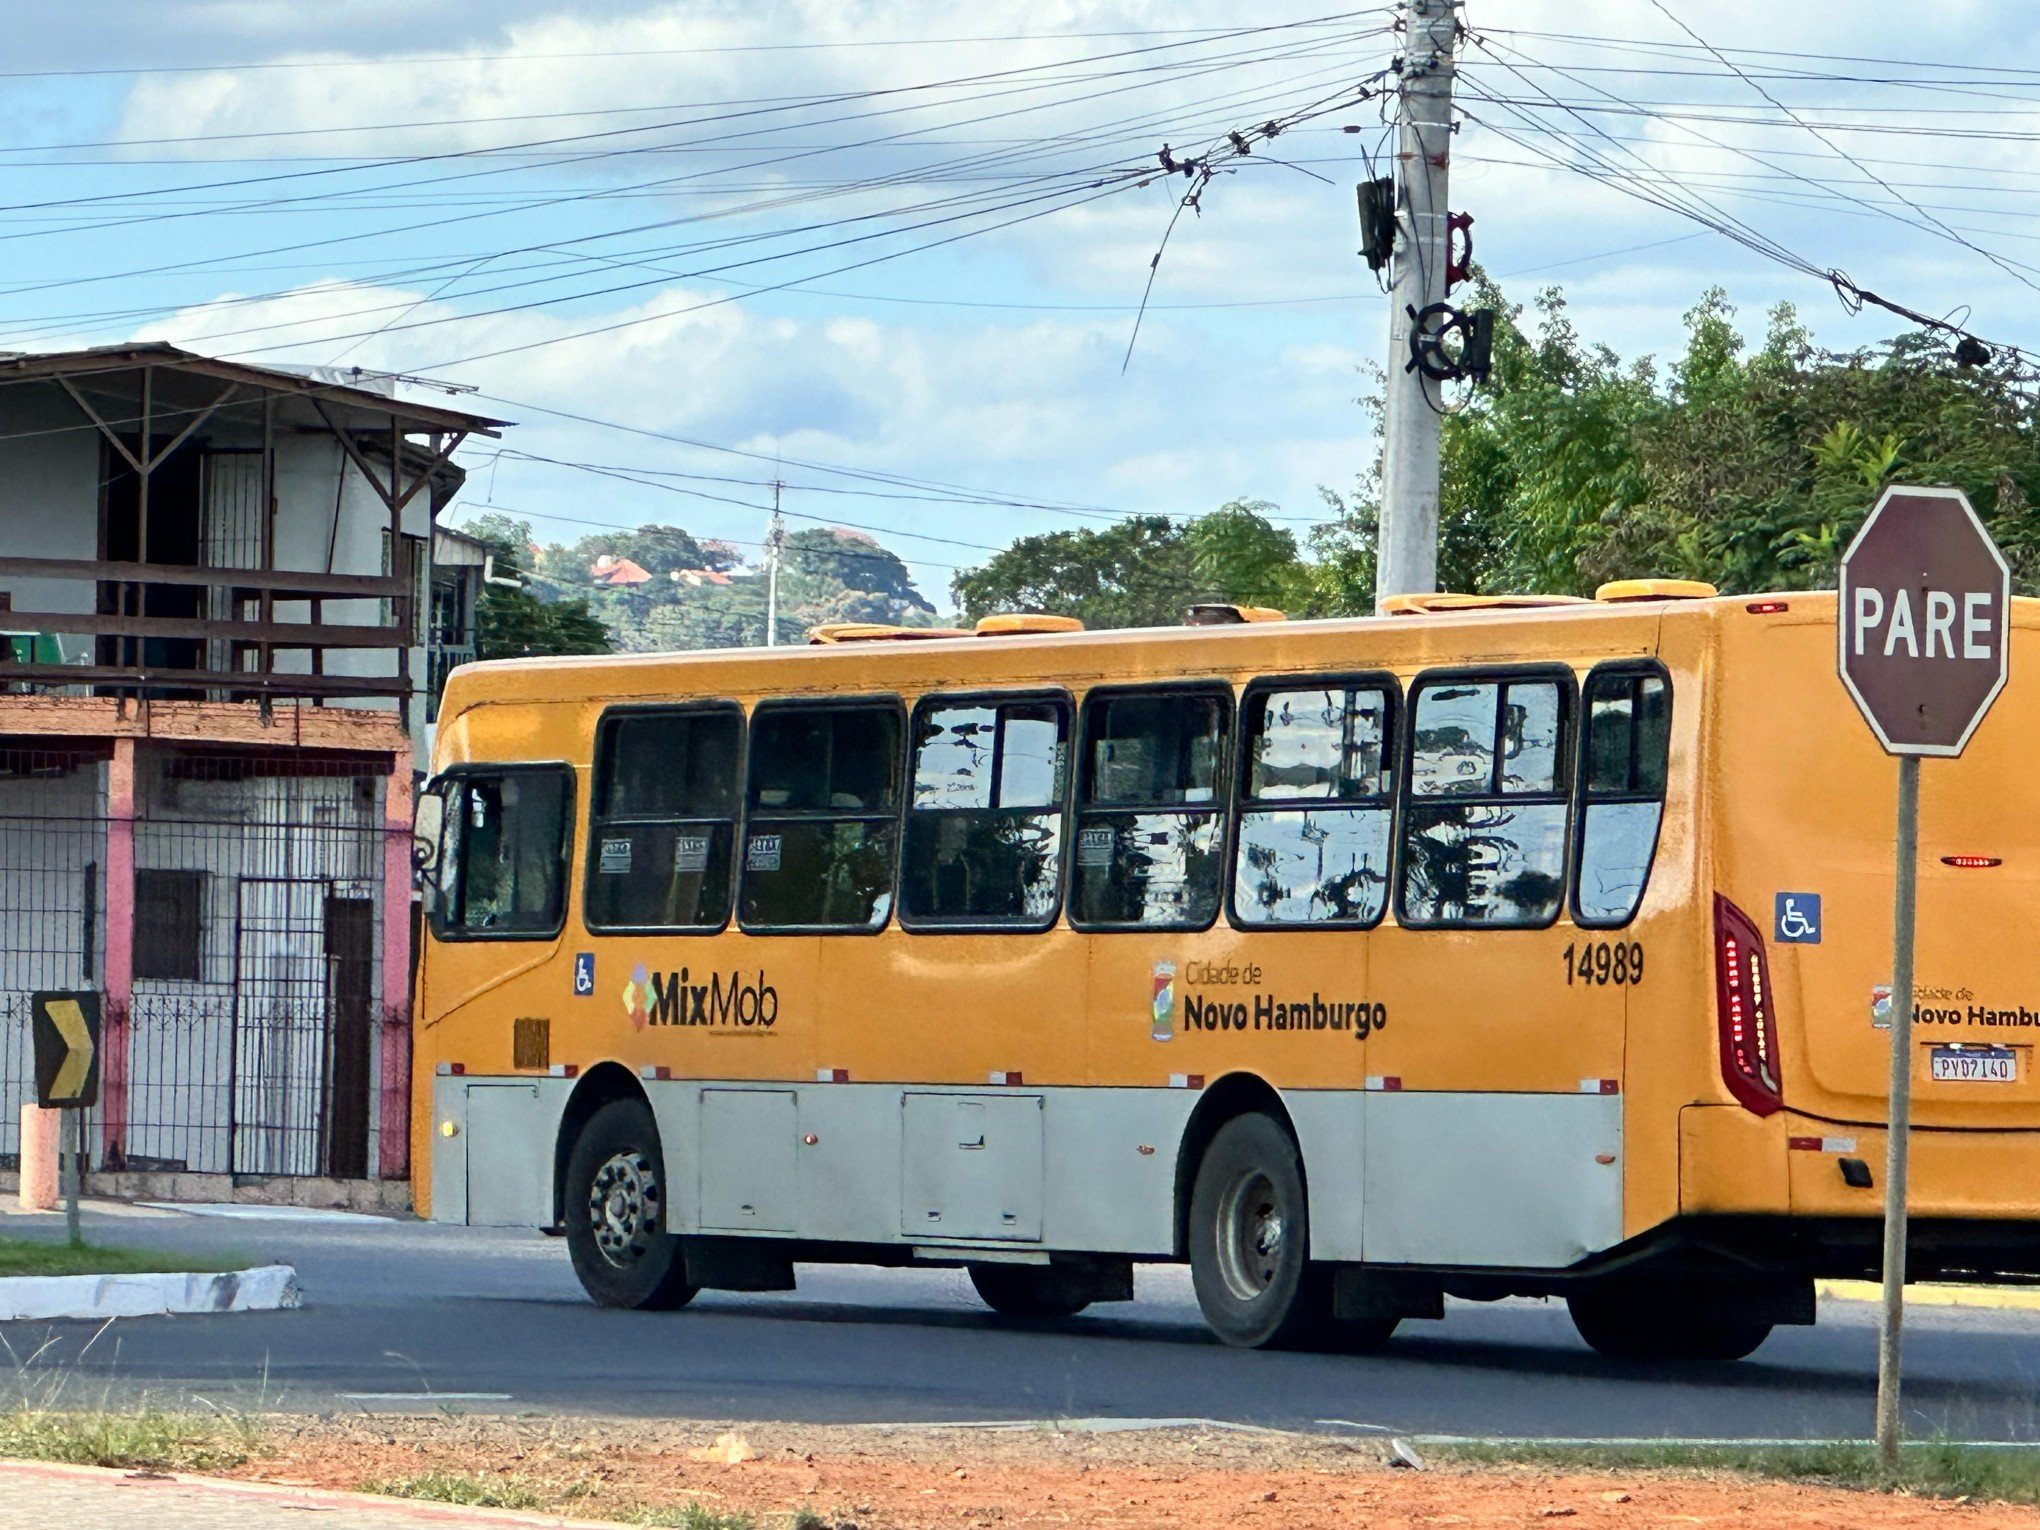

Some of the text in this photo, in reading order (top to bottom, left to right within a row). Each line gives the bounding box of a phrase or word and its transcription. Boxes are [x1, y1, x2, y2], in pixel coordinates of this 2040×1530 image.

[1855, 587, 1991, 659] PARE
[1186, 958, 1262, 985] Cidade de
[1563, 942, 1643, 986] 14989
[649, 966, 778, 1027] MixMob
[1184, 992, 1387, 1040] Novo Hamburgo
